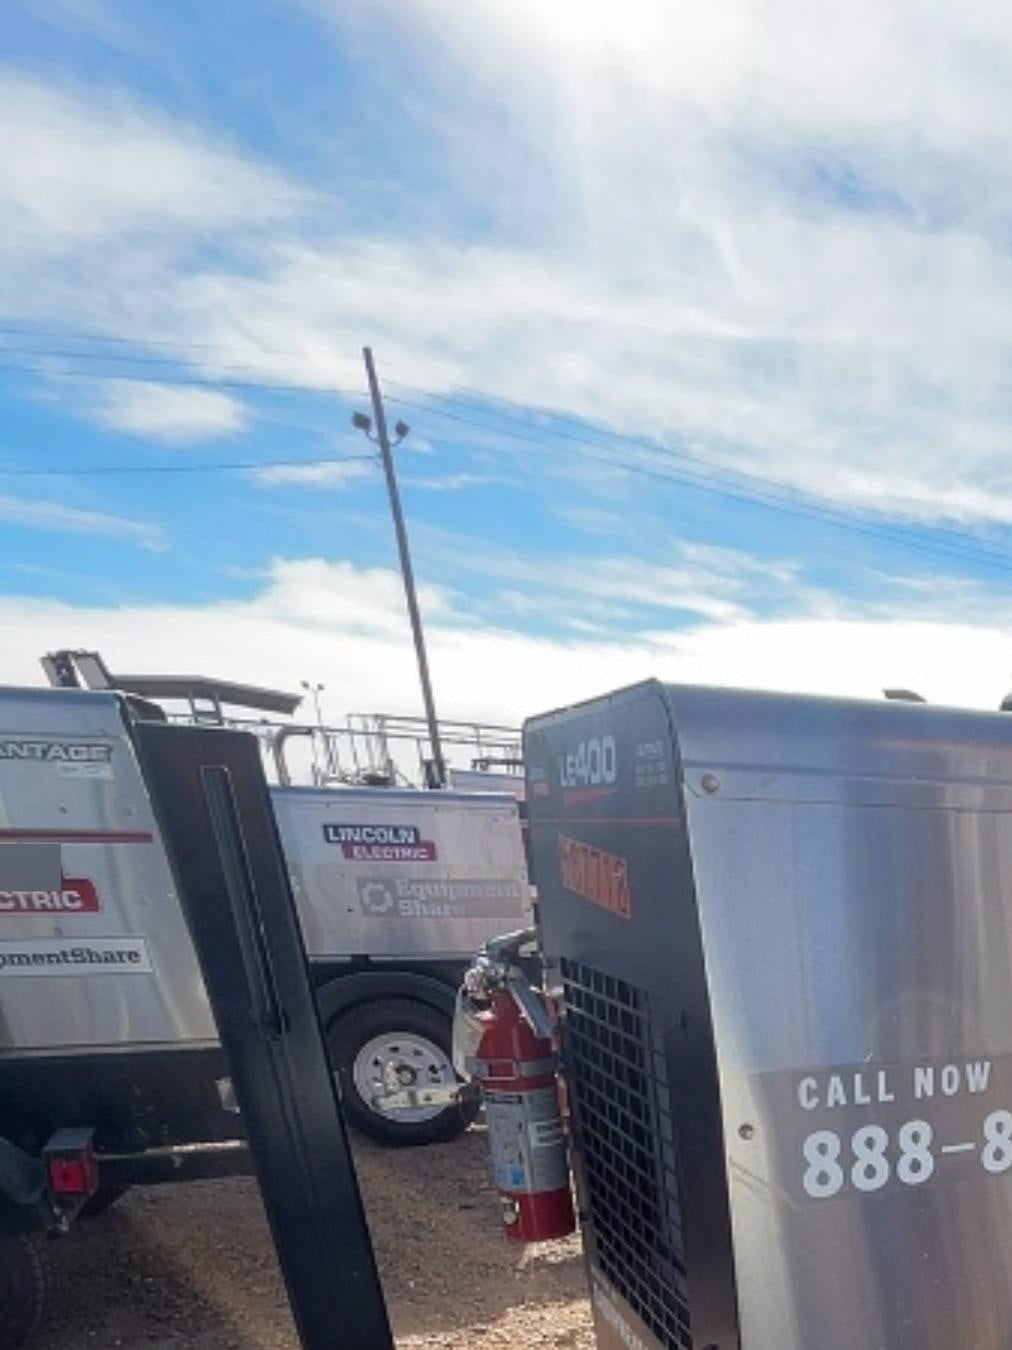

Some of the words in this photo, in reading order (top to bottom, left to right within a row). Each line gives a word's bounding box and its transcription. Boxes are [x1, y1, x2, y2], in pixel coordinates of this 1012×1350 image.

[327, 827, 416, 842] LINCOLN
[352, 846, 430, 860] ELECTRIC
[798, 1070, 895, 1111] CALL
[914, 1061, 992, 1100] NOW
